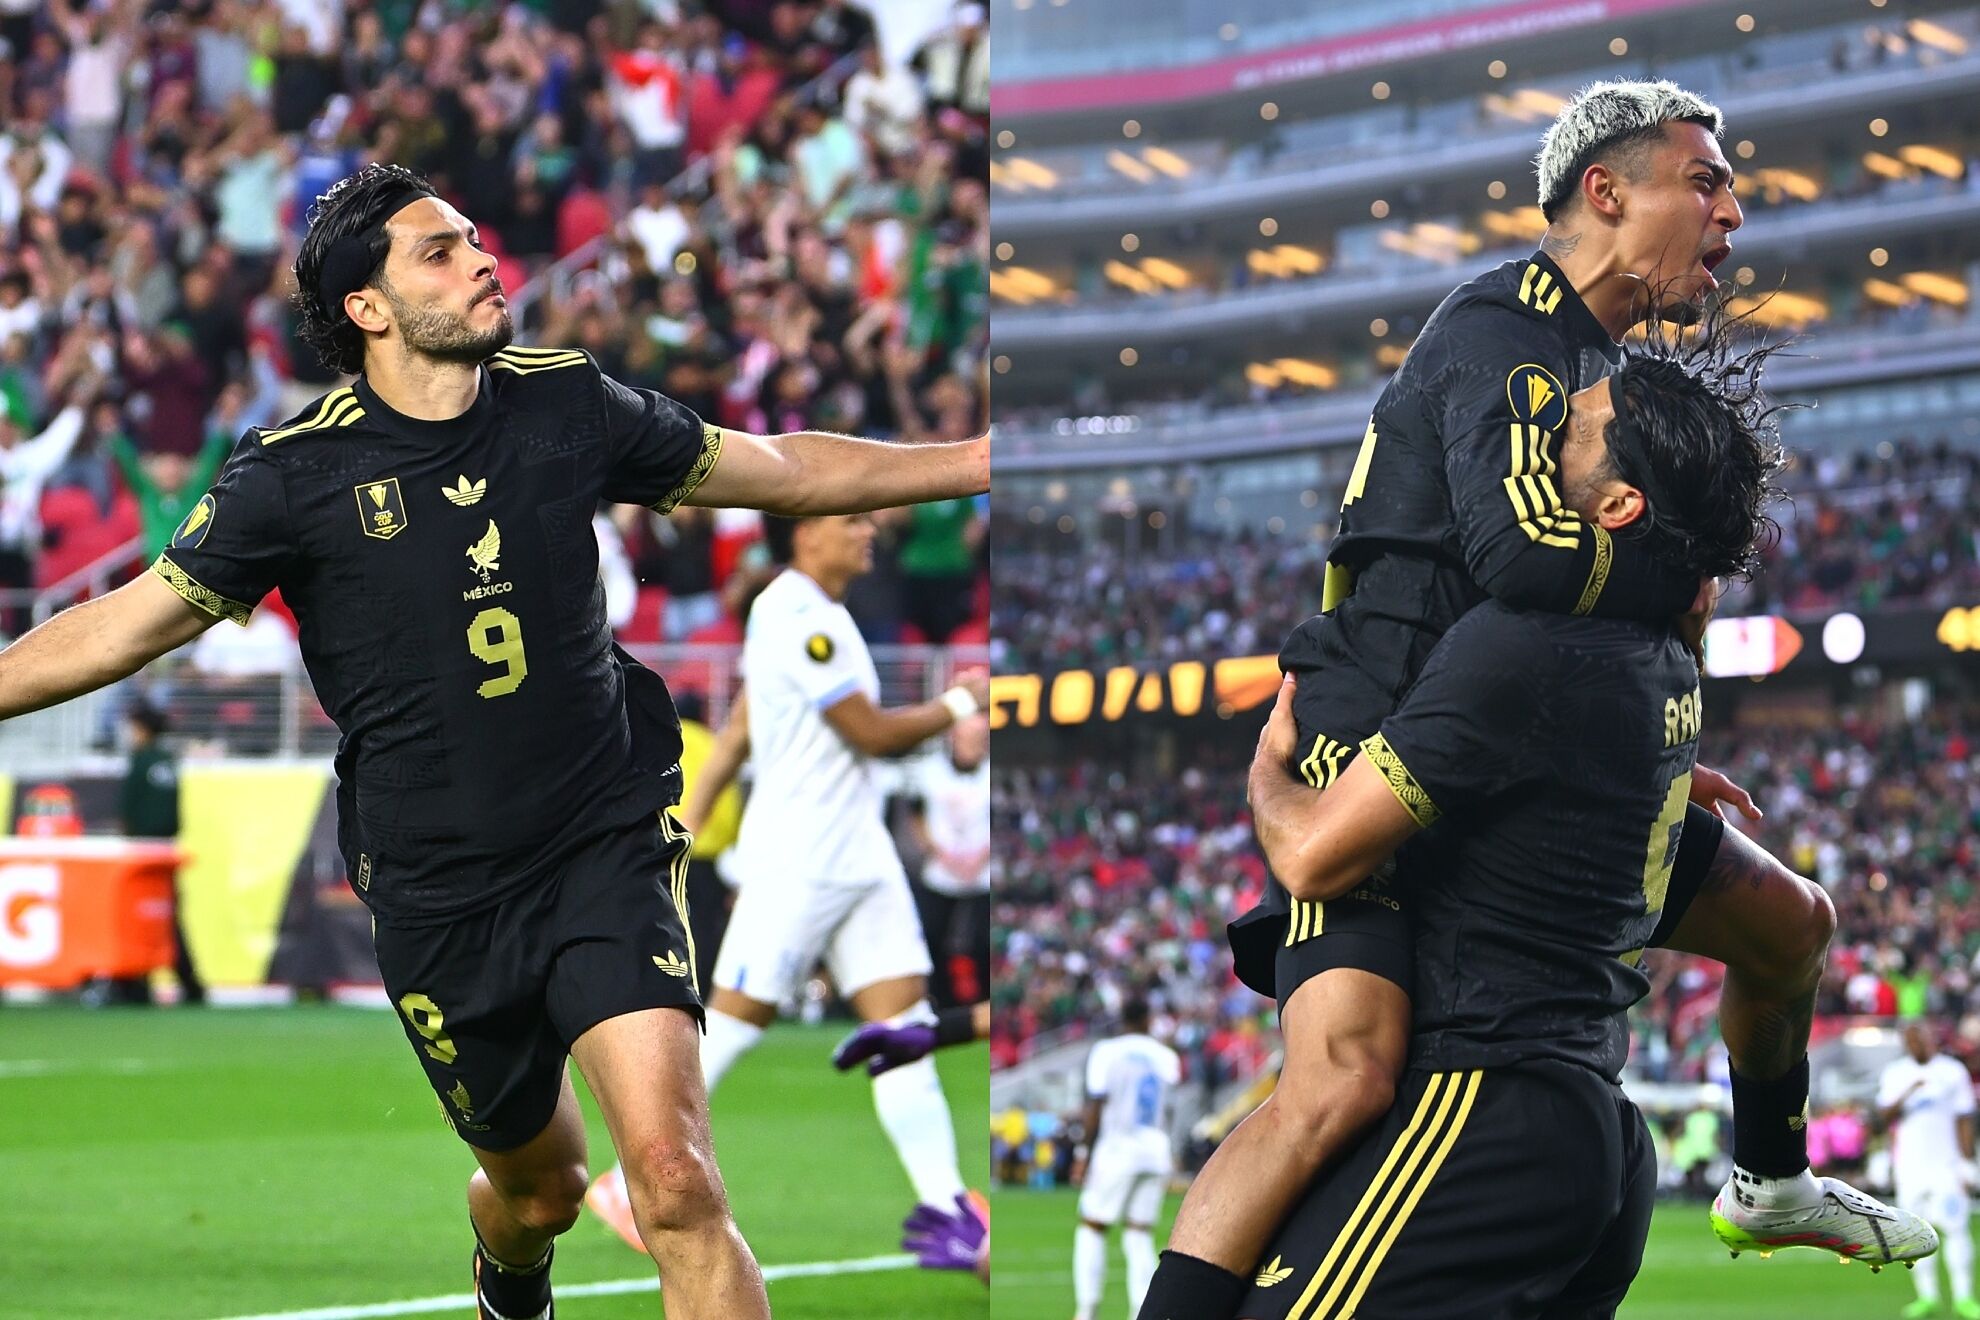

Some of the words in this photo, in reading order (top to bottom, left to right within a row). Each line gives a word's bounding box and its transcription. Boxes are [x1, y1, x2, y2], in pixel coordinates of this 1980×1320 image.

[463, 581, 513, 601] MÉXICO
[466, 606, 528, 699] 9
[0, 863, 62, 966] G
[399, 992, 458, 1065] 9
